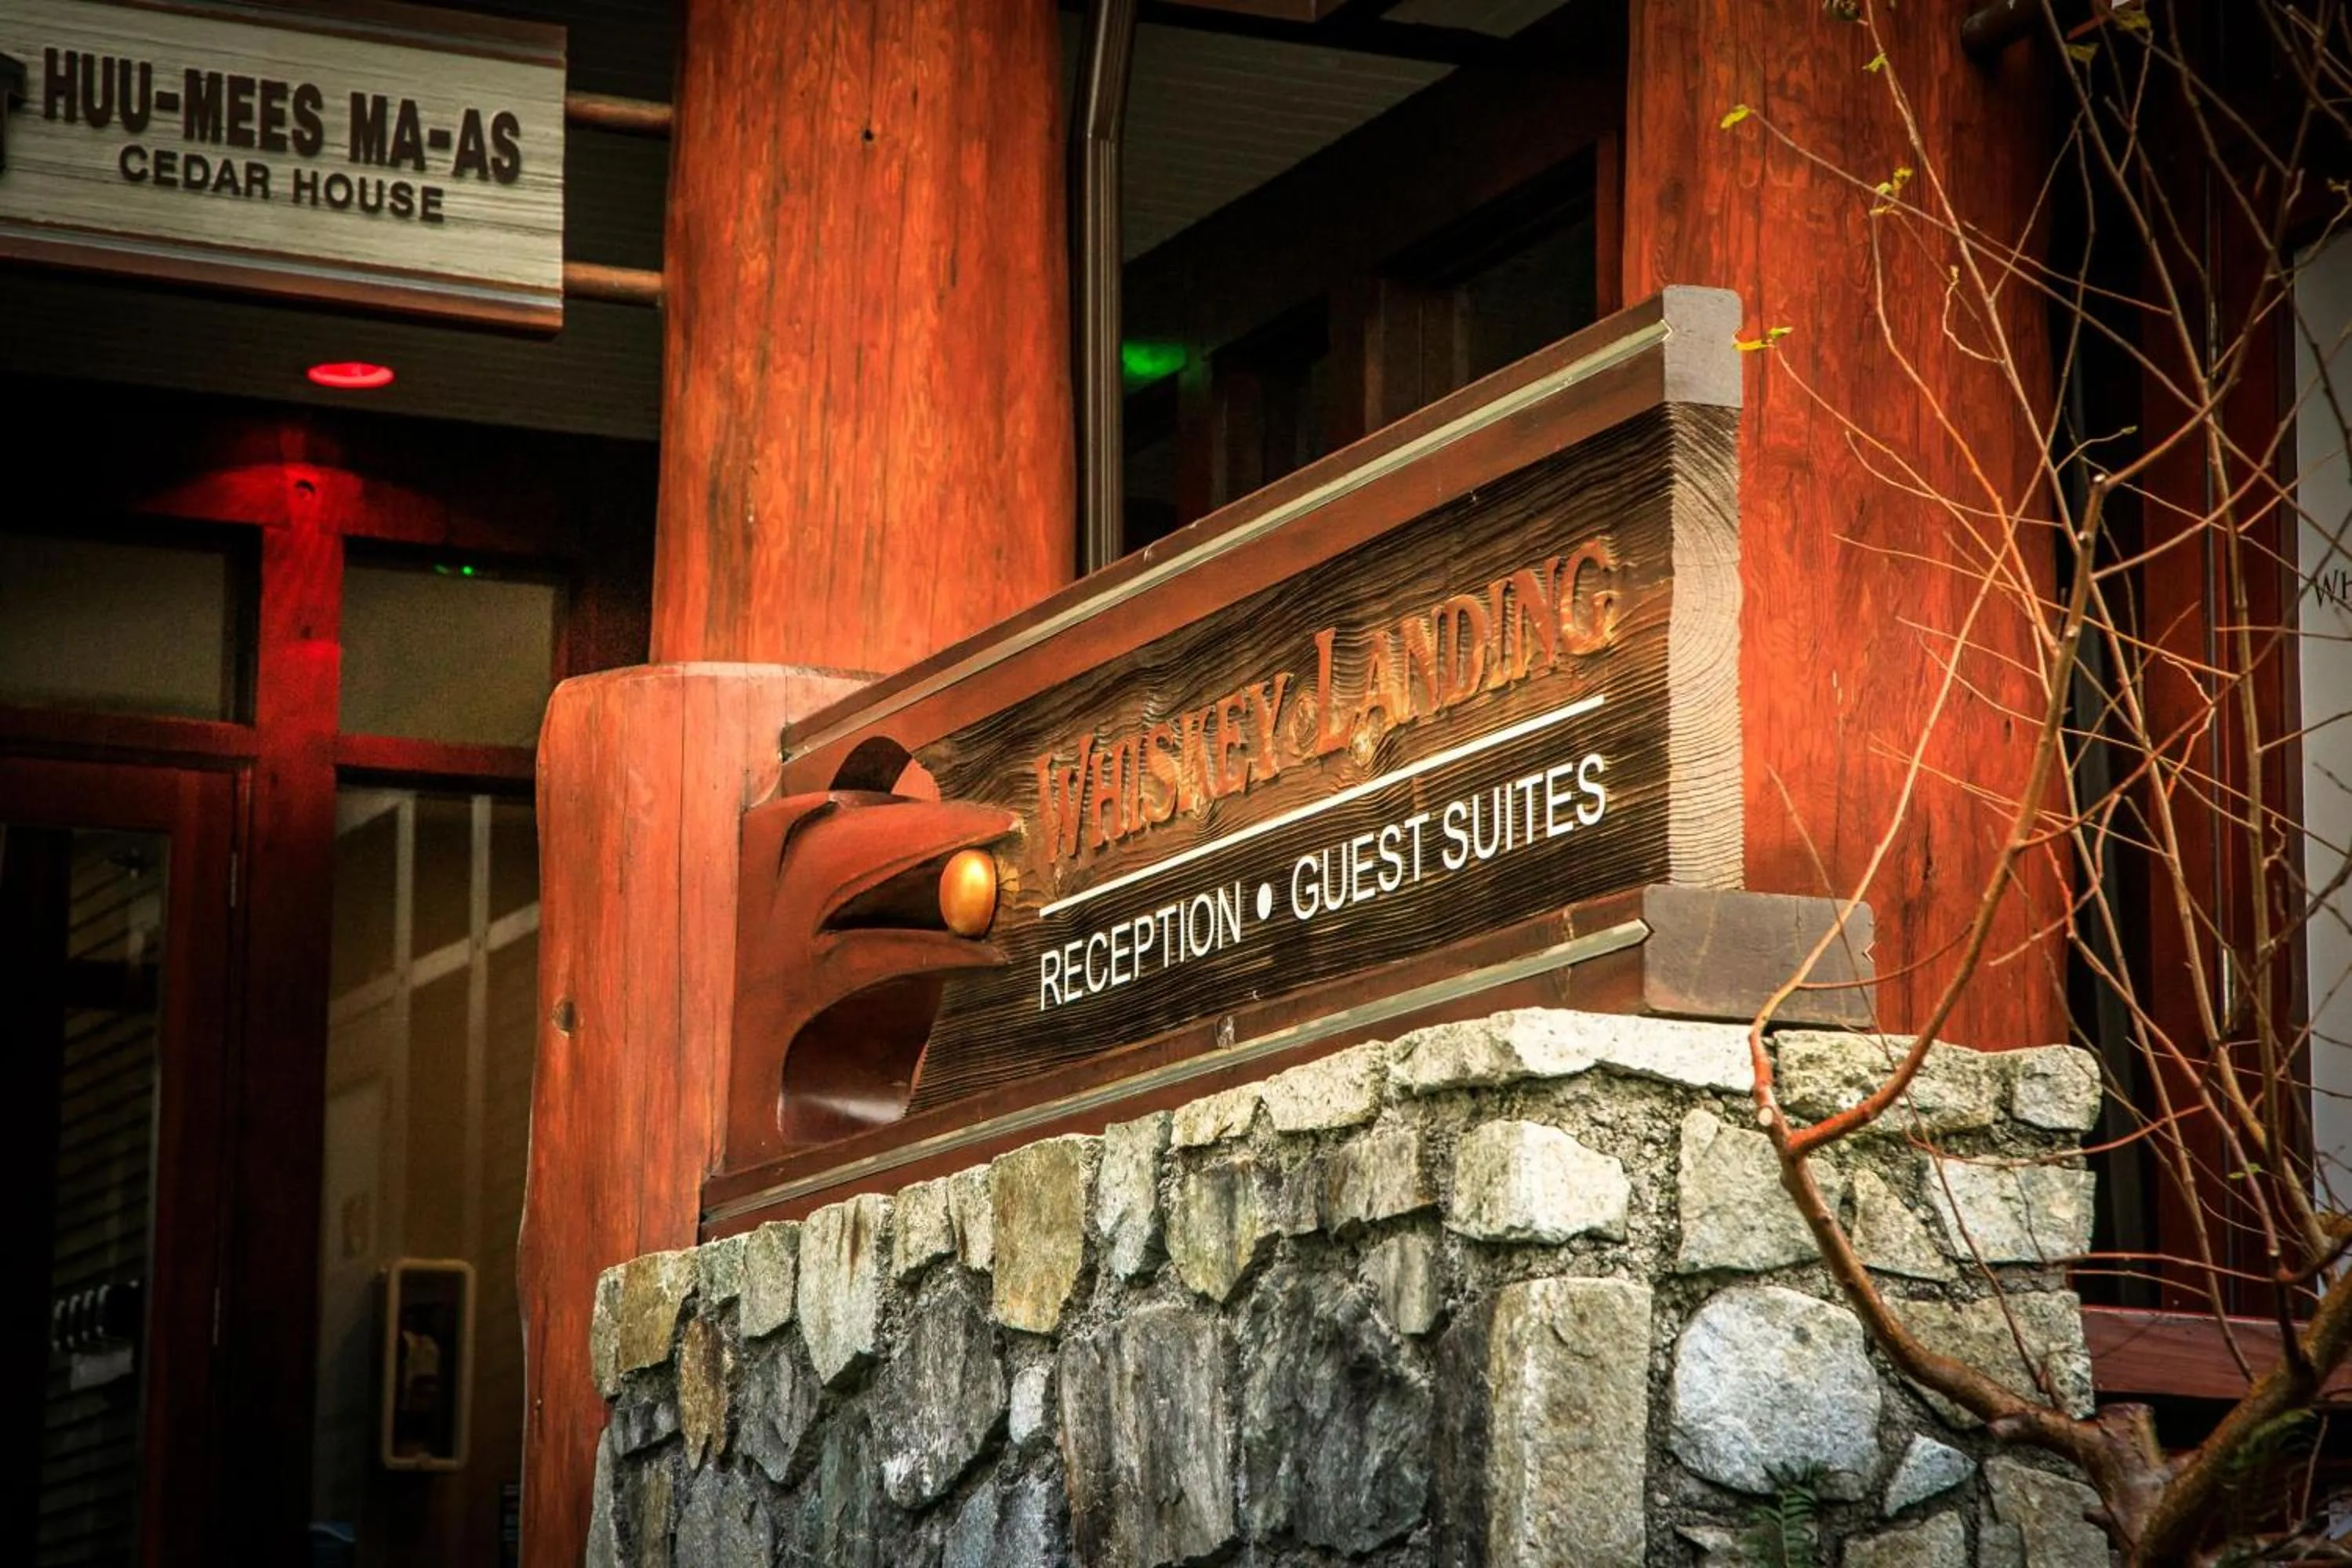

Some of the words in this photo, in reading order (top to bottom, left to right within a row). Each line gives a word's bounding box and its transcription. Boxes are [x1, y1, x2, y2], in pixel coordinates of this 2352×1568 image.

[44, 47, 325, 158] HUU-MEES
[349, 92, 523, 185] MA-AS
[119, 144, 271, 201] CEDAR
[292, 168, 445, 223] HOUSE
[1033, 672, 1294, 866] WHISKEY
[1314, 537, 1621, 755] LANDING
[1040, 881, 1243, 1011] RECEPTION
[1291, 812, 1429, 920] GUEST
[1442, 753, 1608, 872] SUITES
